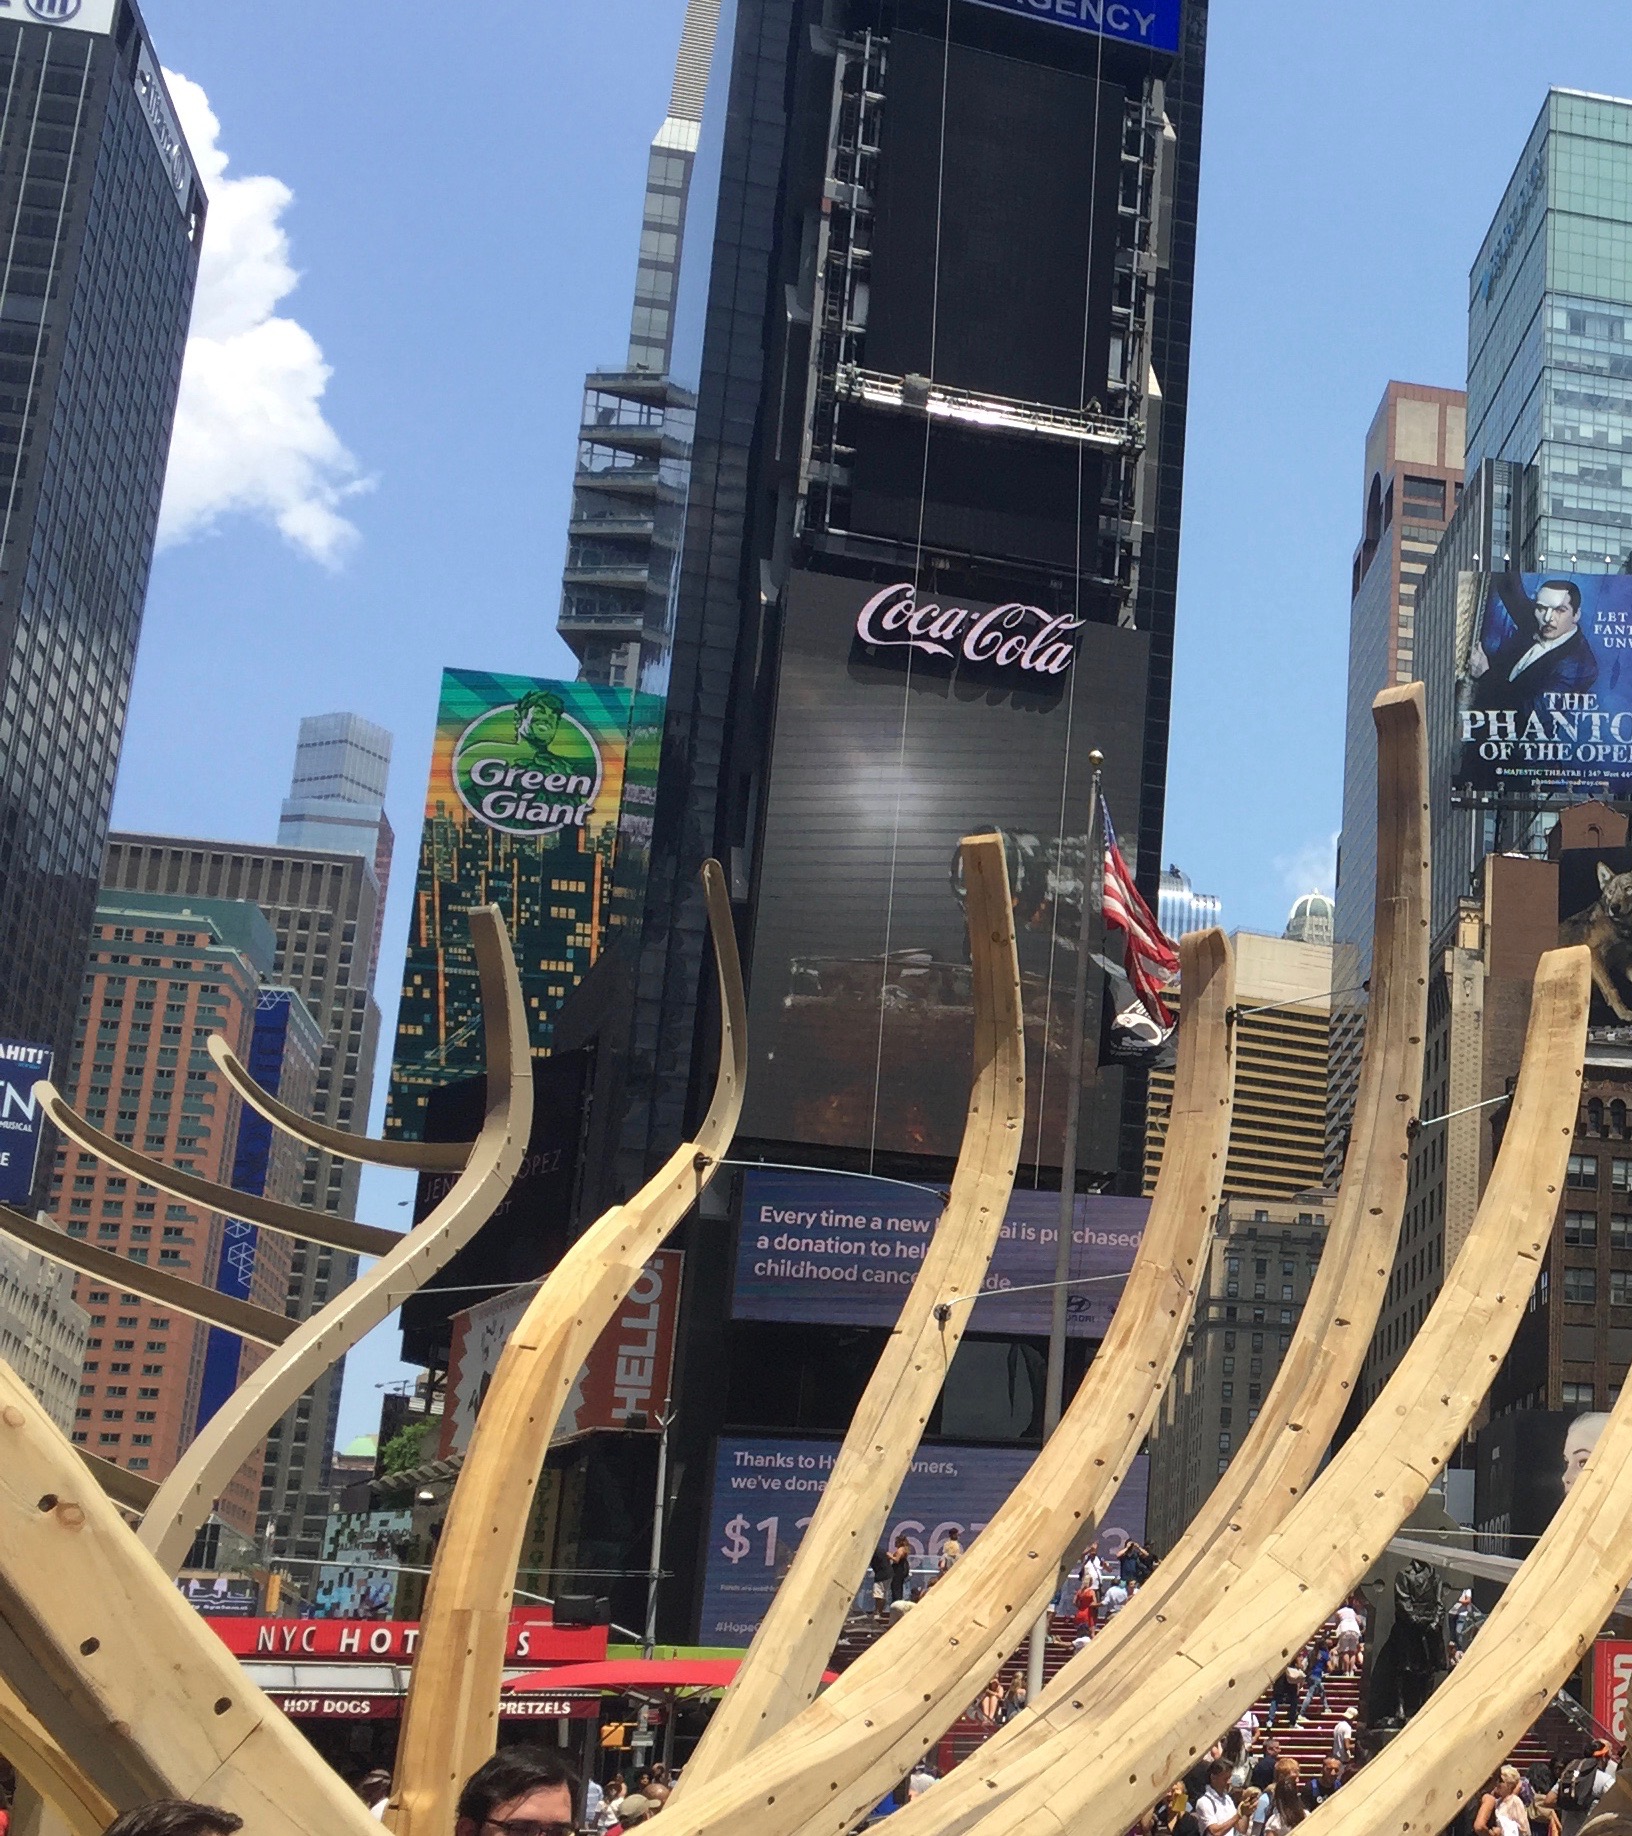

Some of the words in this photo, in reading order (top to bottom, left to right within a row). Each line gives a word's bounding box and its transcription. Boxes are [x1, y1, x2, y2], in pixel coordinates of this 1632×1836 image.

[1597, 612, 1628, 622] LET
[857, 583, 1087, 674] Coca-Cola
[1544, 692, 1599, 711] THE
[1479, 742, 1519, 761] OF
[1519, 743, 1573, 762] THE
[471, 758, 592, 794] Green
[1503, 768, 1542, 776] MAJESTIC
[482, 790, 595, 826] Giant
[517, 1149, 562, 1180] OPEZ
[760, 1206, 817, 1229] Every
[821, 1210, 866, 1229] time
[870, 1218, 882, 1230] a
[886, 1218, 931, 1233] new
[1020, 1223, 1036, 1241] is
[757, 1235, 769, 1250] a
[774, 1233, 865, 1255] donation
[870, 1240, 891, 1257] to
[894, 1241, 929, 1259] hel
[754, 1259, 858, 1281] childhood
[733, 1451, 795, 1468] Thanks
[798, 1453, 815, 1468] to
[731, 1475, 781, 1490] we've
[784, 1476, 827, 1492] dona
[715, 1621, 761, 1634] #Hope
[258, 1625, 317, 1651] NYC
[339, 1624, 420, 1653] HOT
[284, 1699, 318, 1713] HOT
[323, 1700, 371, 1714] DOGS
[498, 1701, 570, 1714] PRETZELS
